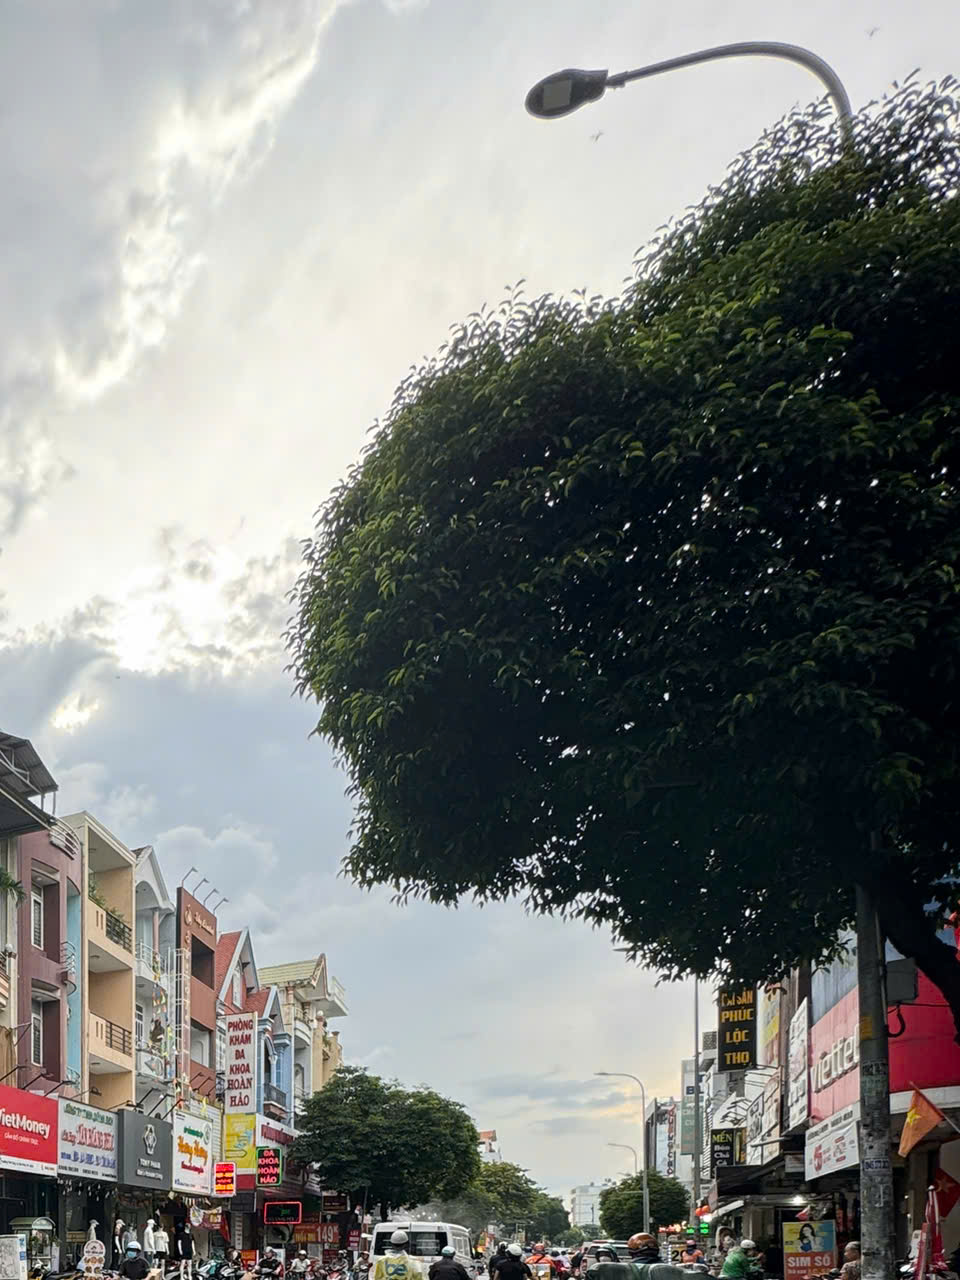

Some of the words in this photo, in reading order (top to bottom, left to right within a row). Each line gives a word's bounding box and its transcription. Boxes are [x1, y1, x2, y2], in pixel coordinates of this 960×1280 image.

[721, 1007, 754, 1023] PHÚC
[227, 1019, 254, 1032] PHÒNG
[229, 1033, 252, 1046] KHÁM
[725, 1028, 749, 1045] LỘC
[235, 1049, 245, 1060] ĐA
[724, 1051, 750, 1066] THỌ
[229, 1063, 251, 1075] KHOA
[227, 1077, 253, 1090] HOÀN
[787, 1256, 812, 1267] SIM
